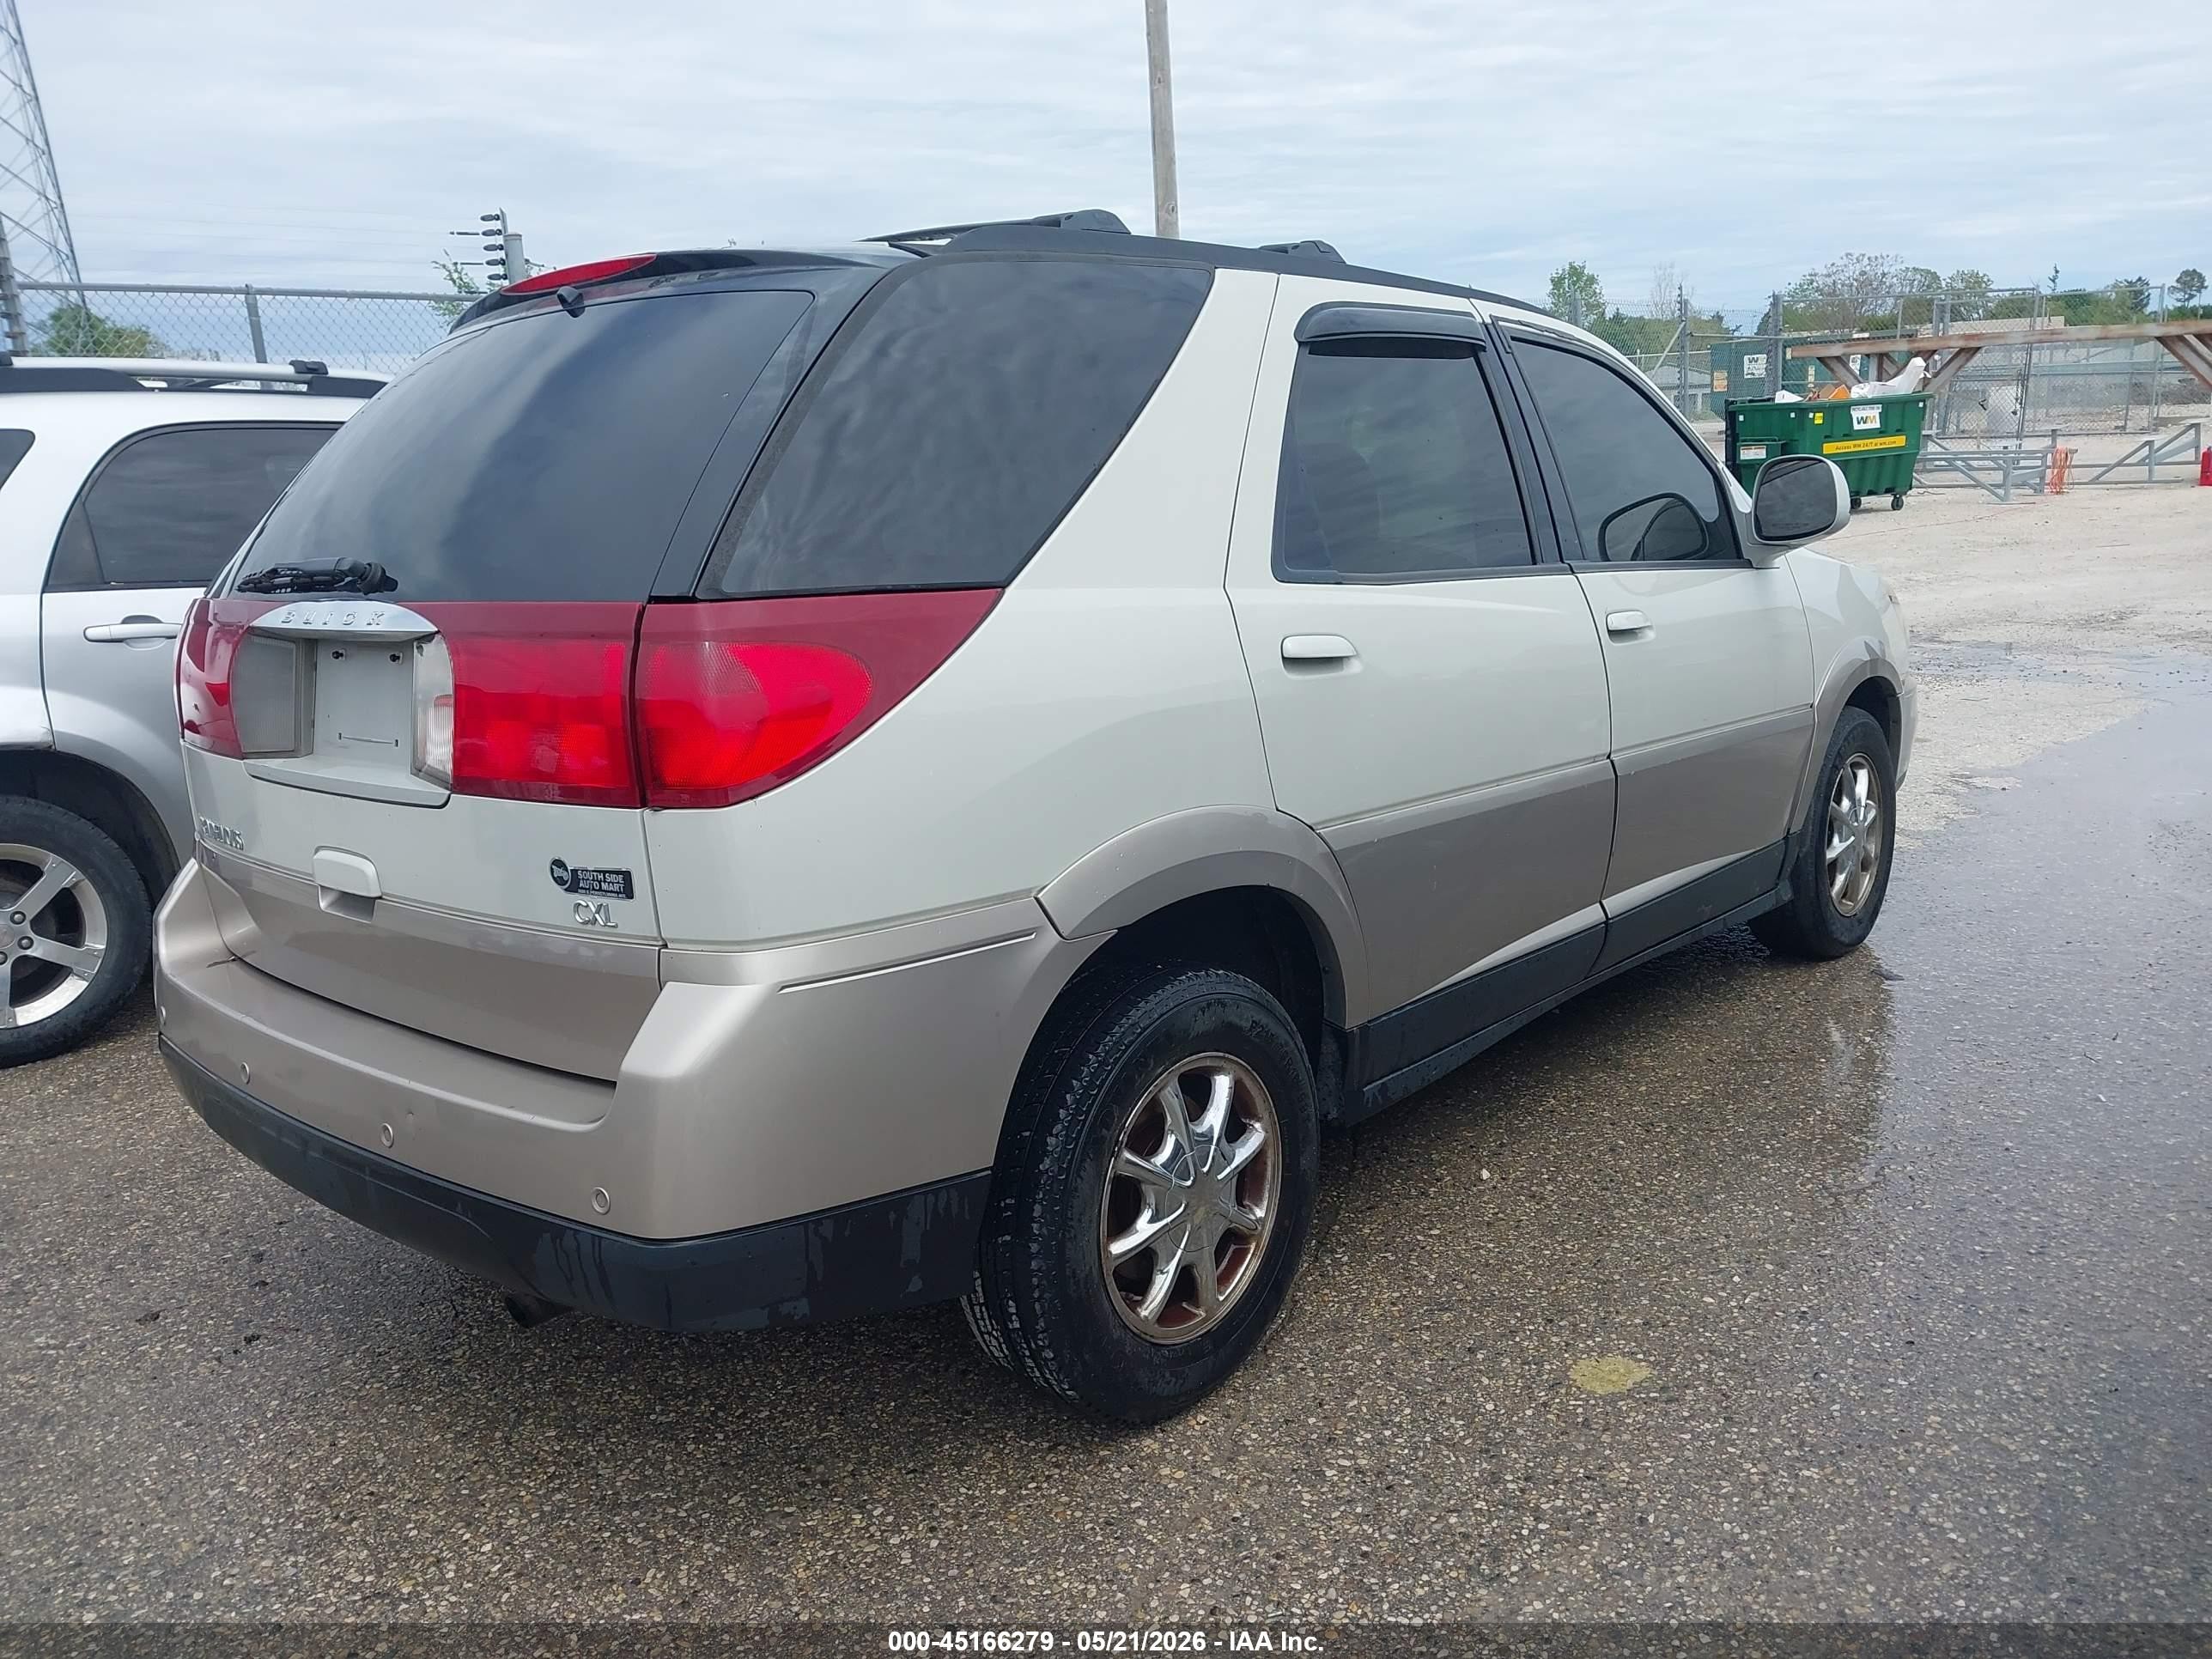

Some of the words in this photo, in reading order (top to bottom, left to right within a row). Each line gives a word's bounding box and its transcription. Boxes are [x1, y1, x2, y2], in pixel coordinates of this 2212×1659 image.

[1856, 415, 1877, 425] WM
[281, 611, 386, 626] BUICK
[577, 870, 604, 882] SOUTH
[605, 872, 624, 884] SIDE
[579, 878, 599, 890] AUTO
[601, 881, 625, 892] MART
[573, 898, 618, 928] CXL
